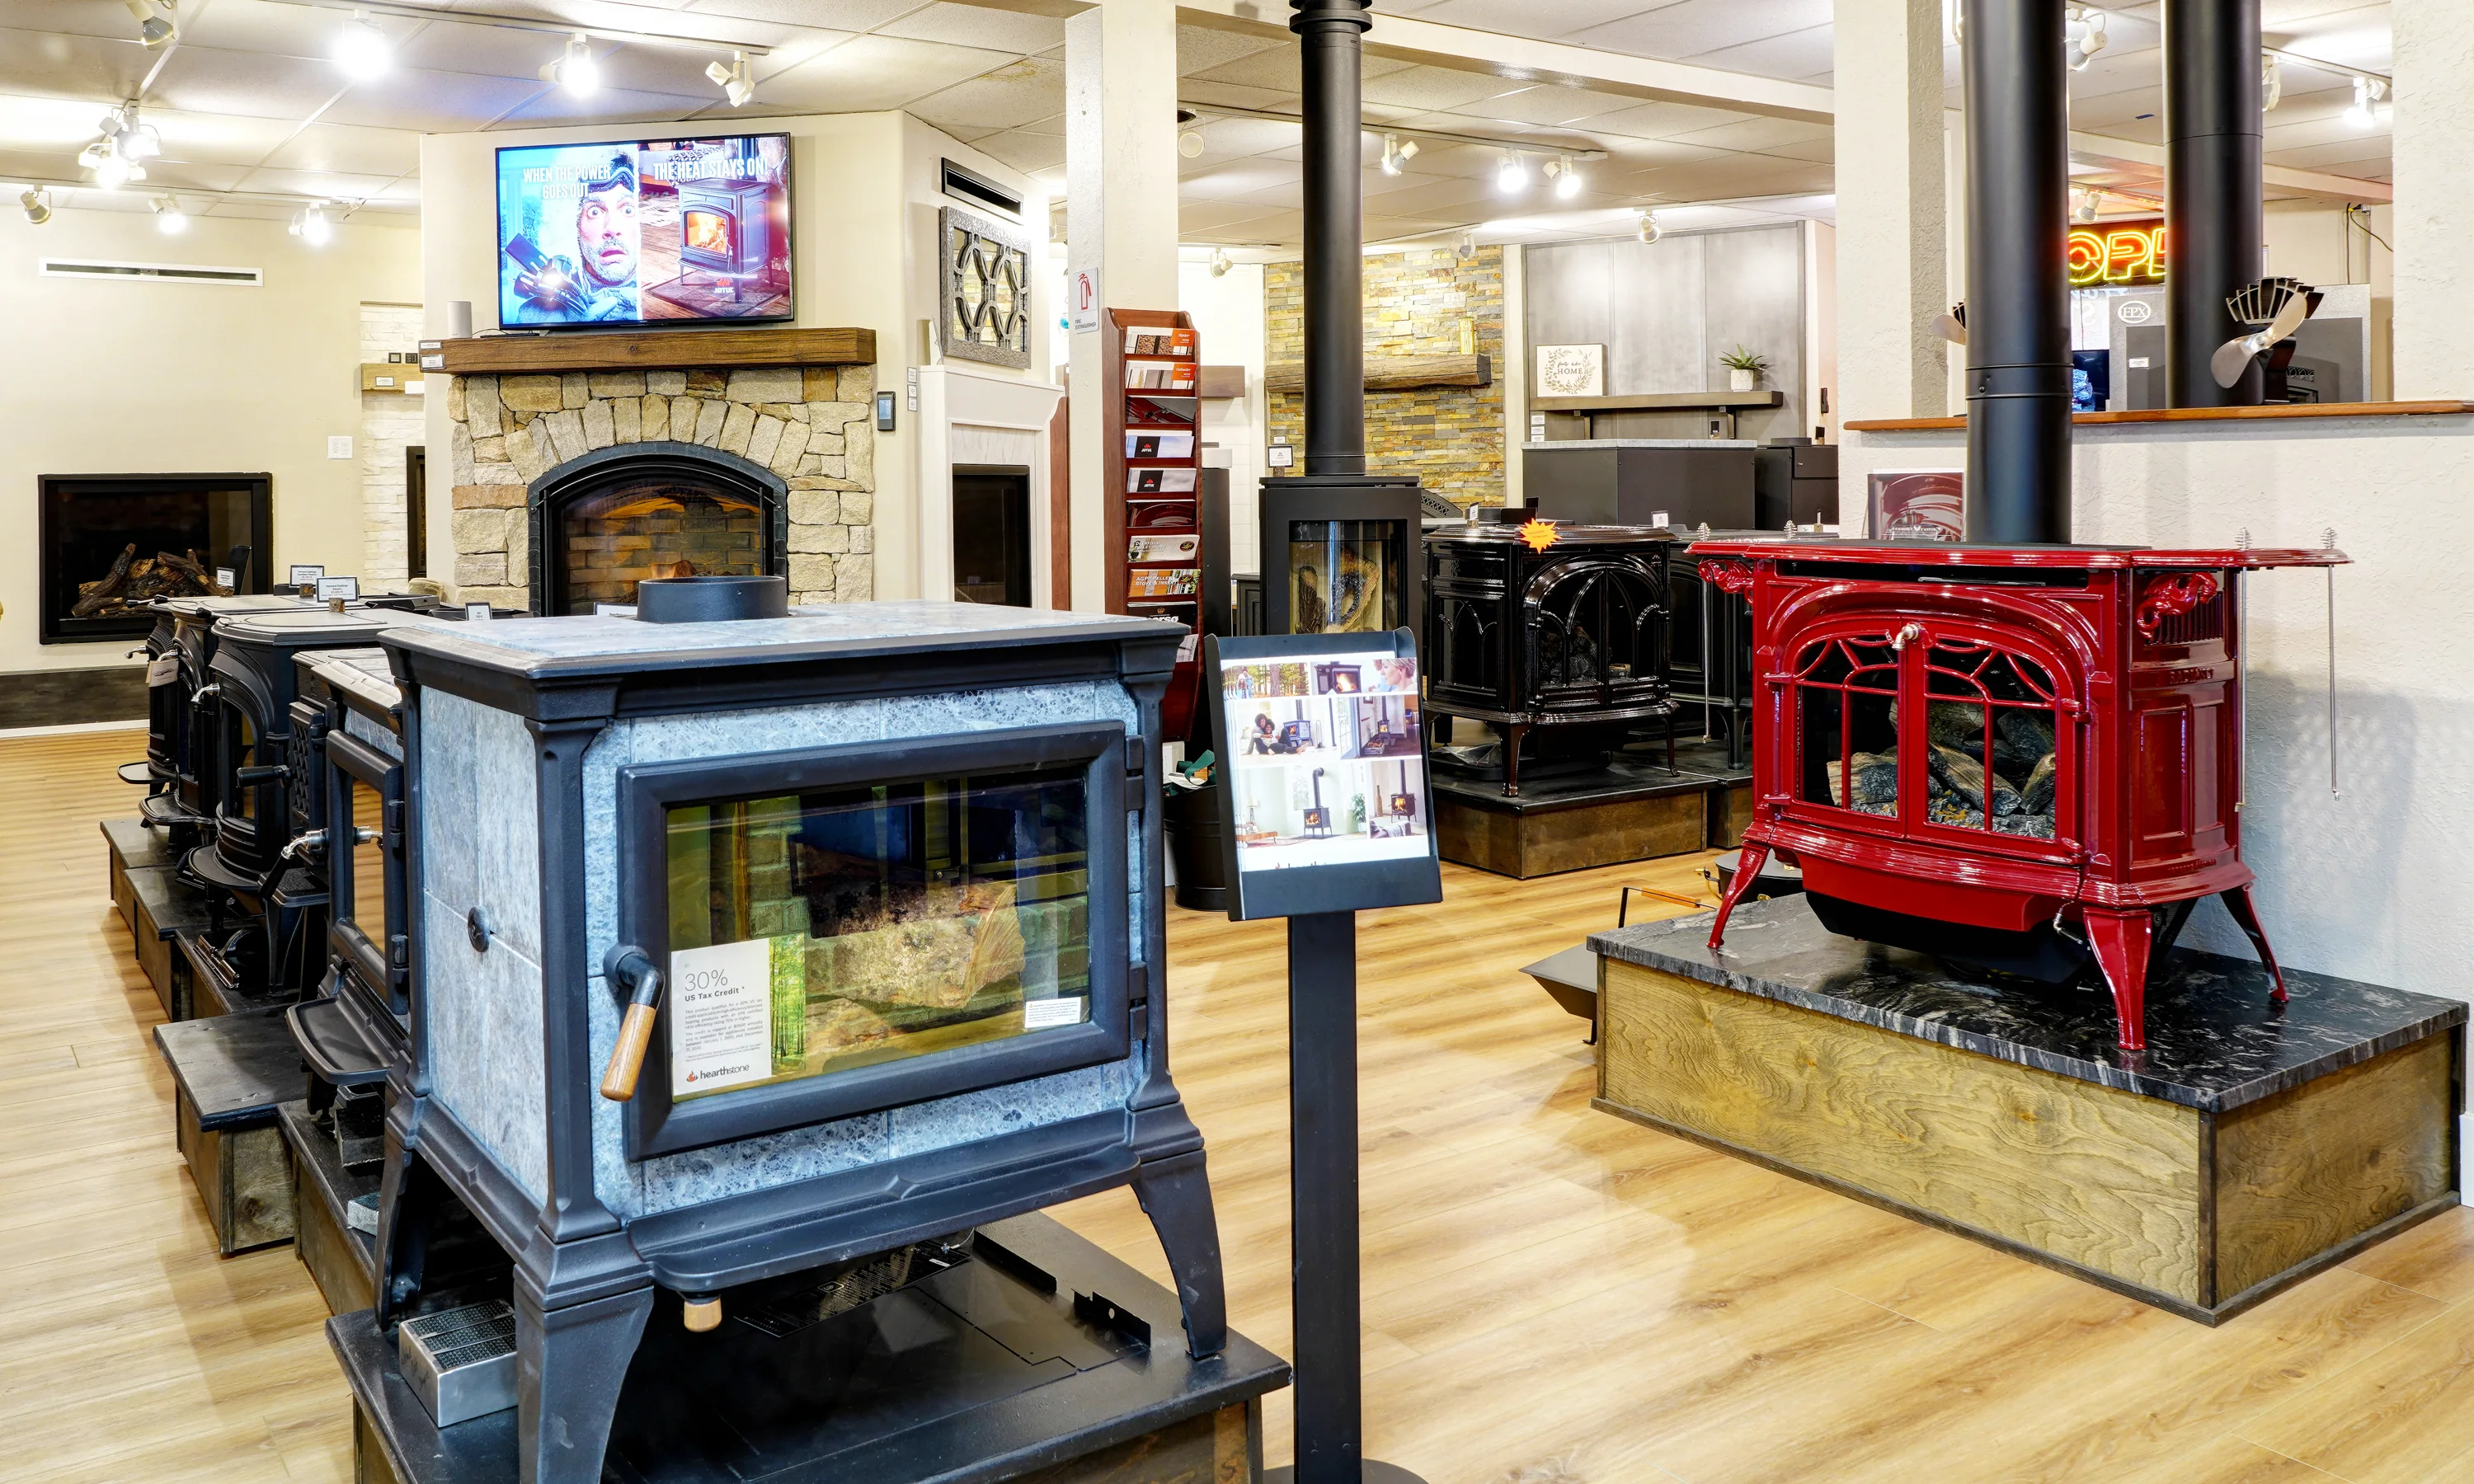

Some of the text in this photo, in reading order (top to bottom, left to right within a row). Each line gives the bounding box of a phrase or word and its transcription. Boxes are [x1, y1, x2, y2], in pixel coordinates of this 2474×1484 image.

[523, 164, 610, 183] WHEN THE POWER
[653, 157, 768, 180] THE HEAT STAYS ON!
[542, 183, 589, 199] GOES OUT
[2123, 307, 2147, 318] FPX
[684, 969, 728, 992] 30%
[714, 987, 740, 997] Credit
[700, 1064, 750, 1079] hearthstone
